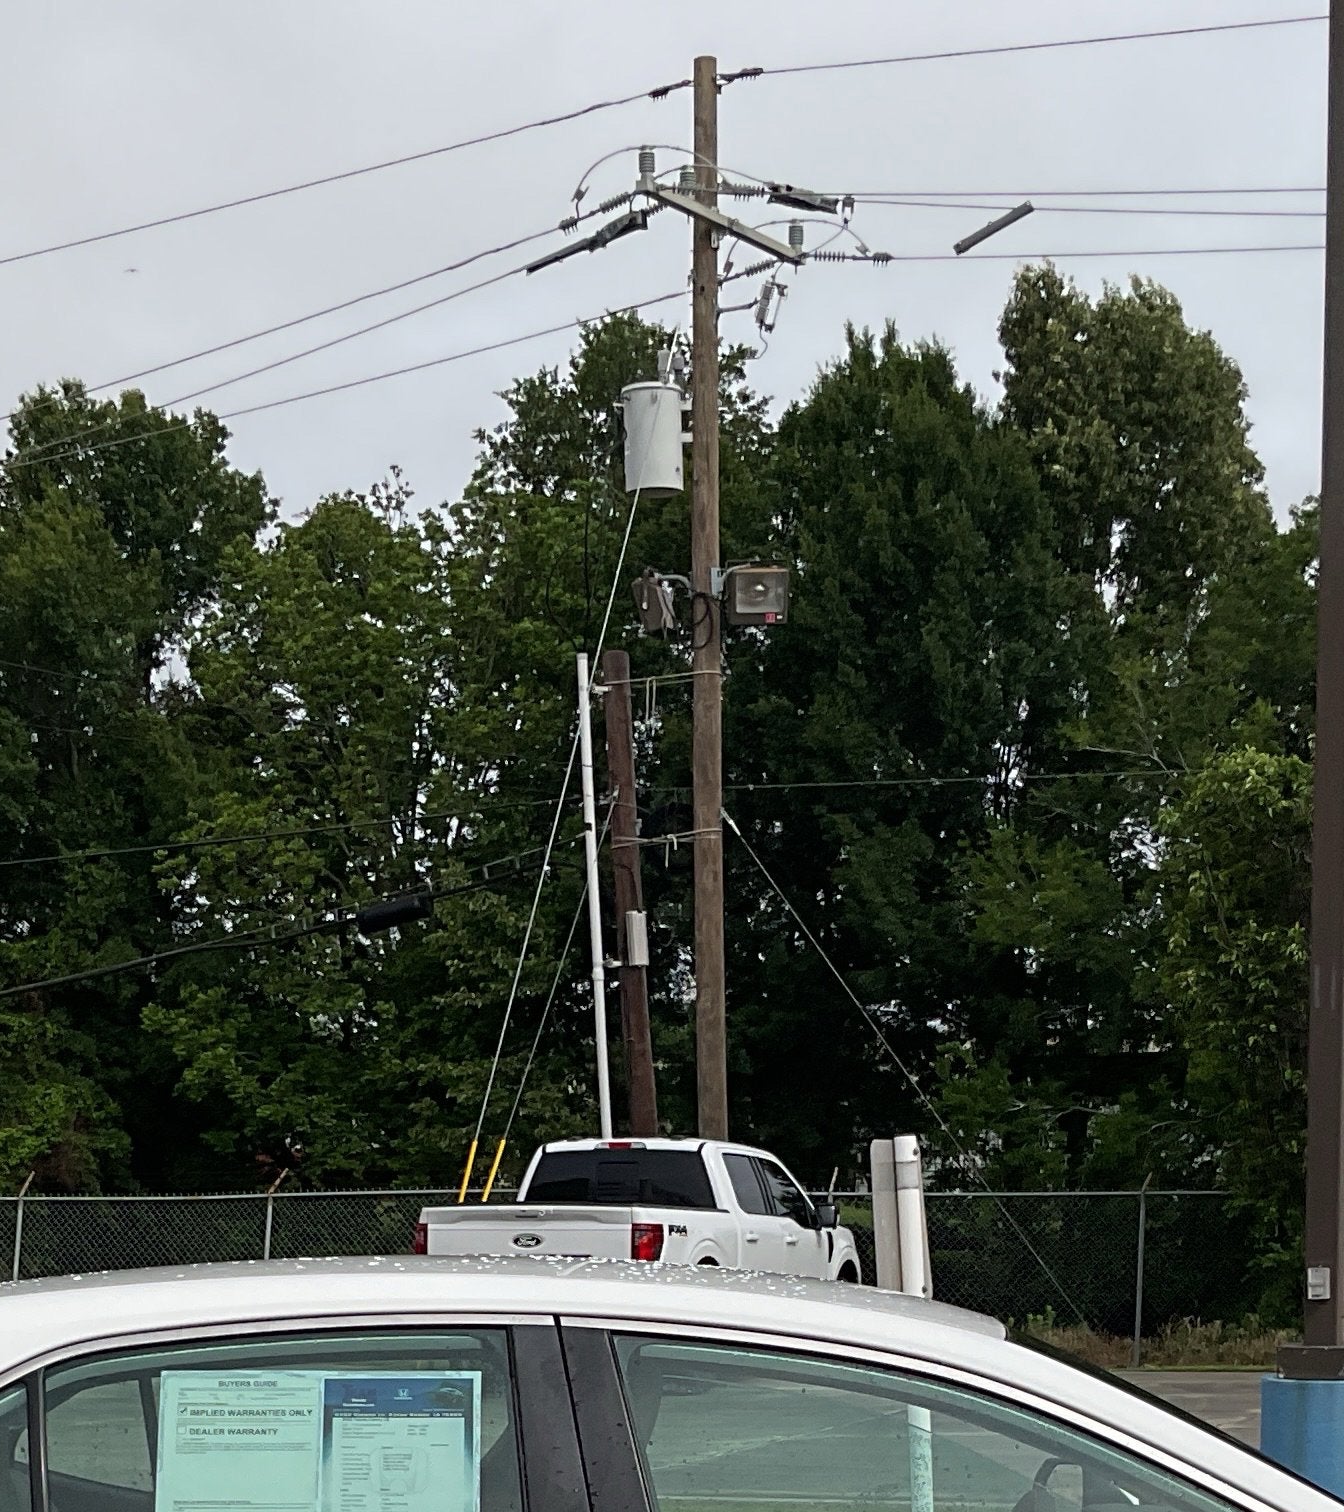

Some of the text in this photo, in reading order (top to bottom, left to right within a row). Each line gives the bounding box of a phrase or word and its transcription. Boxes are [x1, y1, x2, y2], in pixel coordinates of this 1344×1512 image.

[189, 1409, 313, 1417] IMPLIED WARRANTIES ONLY
[189, 1428, 278, 1436] DEALER WARRANTY
